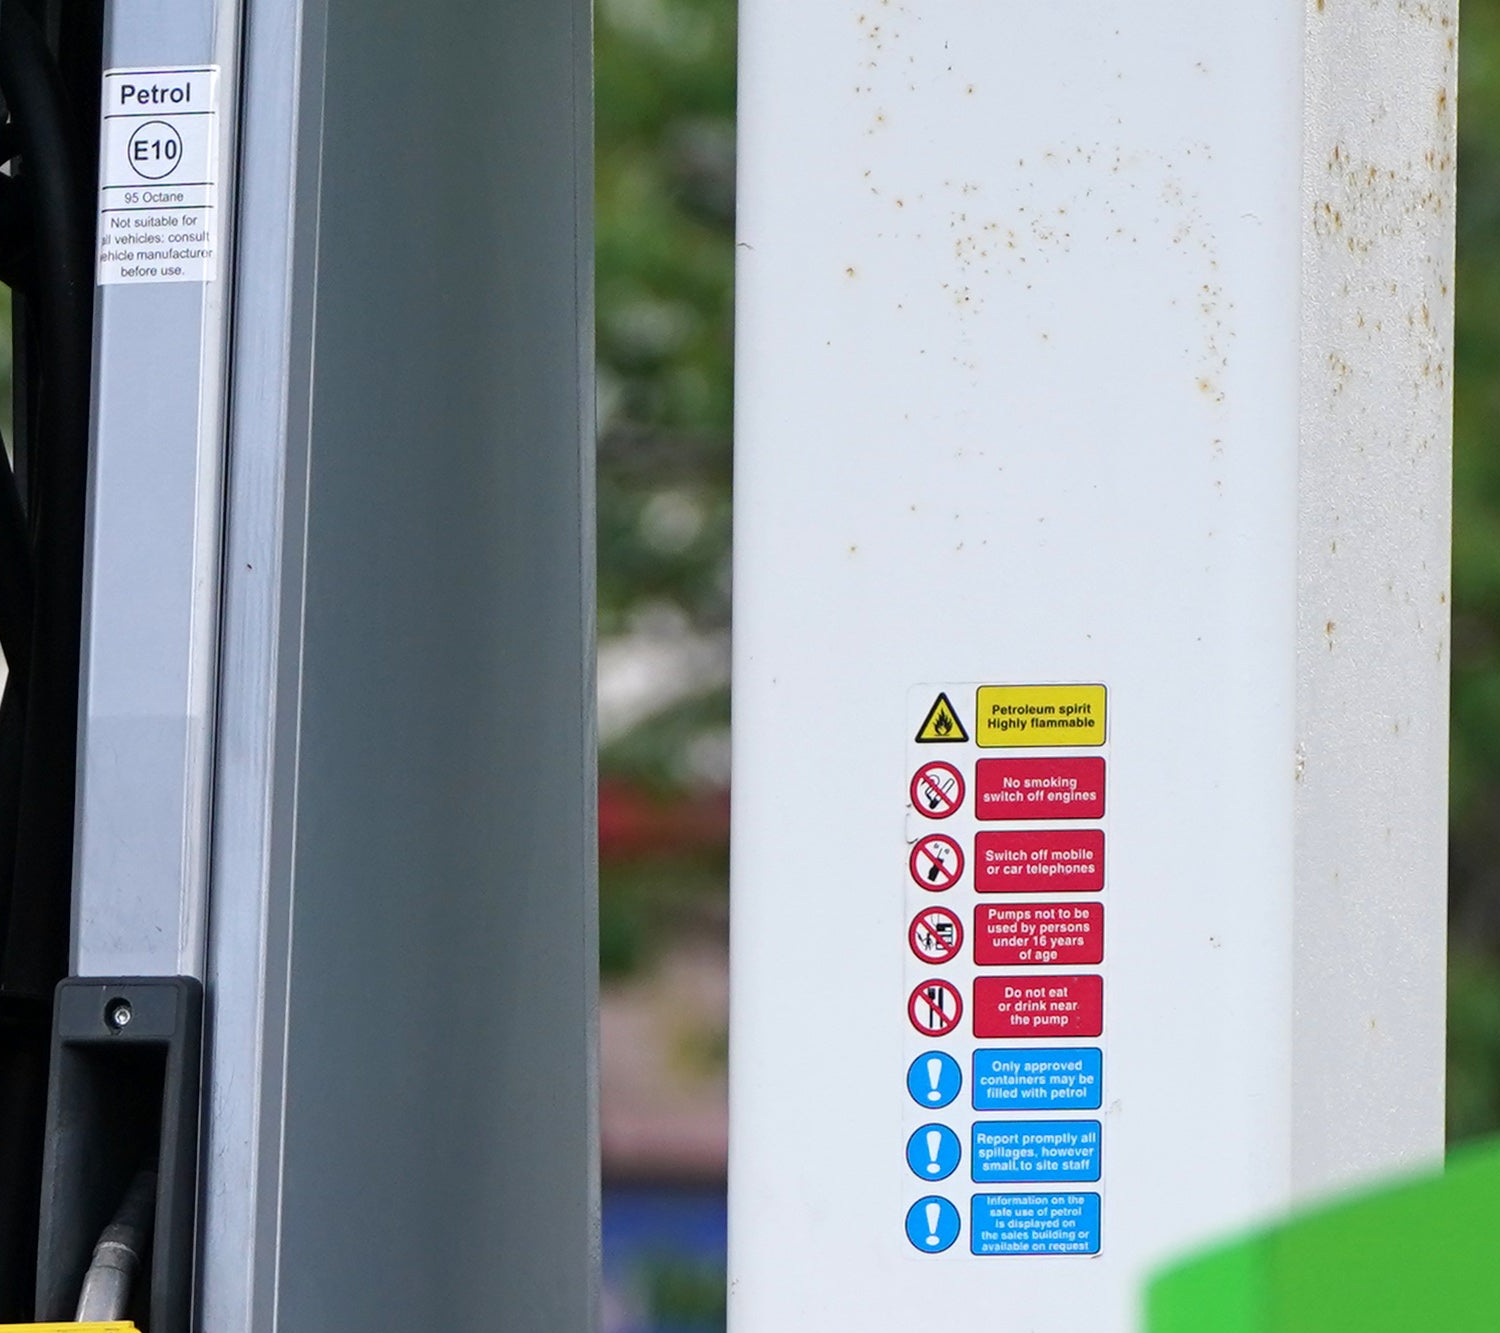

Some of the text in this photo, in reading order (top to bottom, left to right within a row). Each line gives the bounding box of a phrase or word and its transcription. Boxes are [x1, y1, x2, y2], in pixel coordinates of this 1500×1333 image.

[121, 82, 190, 105] Petrol
[134, 139, 177, 160] E10
[125, 192, 184, 204] 95 Octane
[111, 215, 197, 228] Not suitable for
[115, 230, 209, 245] vehicles: consult
[137, 248, 213, 260] manufacturer
[121, 266, 184, 277] before use.
[992, 704, 1090, 717] Petroleum spirit
[988, 718, 1094, 730] Highly flammable
[1003, 777, 1077, 790] No smoking
[983, 791, 1096, 804] switch off engines
[986, 849, 1093, 861] Switch off mobile
[987, 863, 1095, 875] or car telephones
[989, 908, 1089, 921] Pumps not to be
[988, 923, 1090, 935] used by persons
[993, 936, 1084, 948] under 16 years
[1019, 950, 1057, 963] of age
[1005, 987, 1068, 998] Do not eat
[998, 1001, 1078, 1012] or drink near
[1010, 1015, 1068, 1026] the pump
[992, 1060, 1082, 1075] Only approved
[980, 1074, 1094, 1087] containers may be
[987, 1086, 1087, 1100] filled with petrol
[977, 1132, 1096, 1146] Report promptly all
[1042, 1147, 1094, 1157] however
[1021, 1160, 1089, 1170] to site staff
